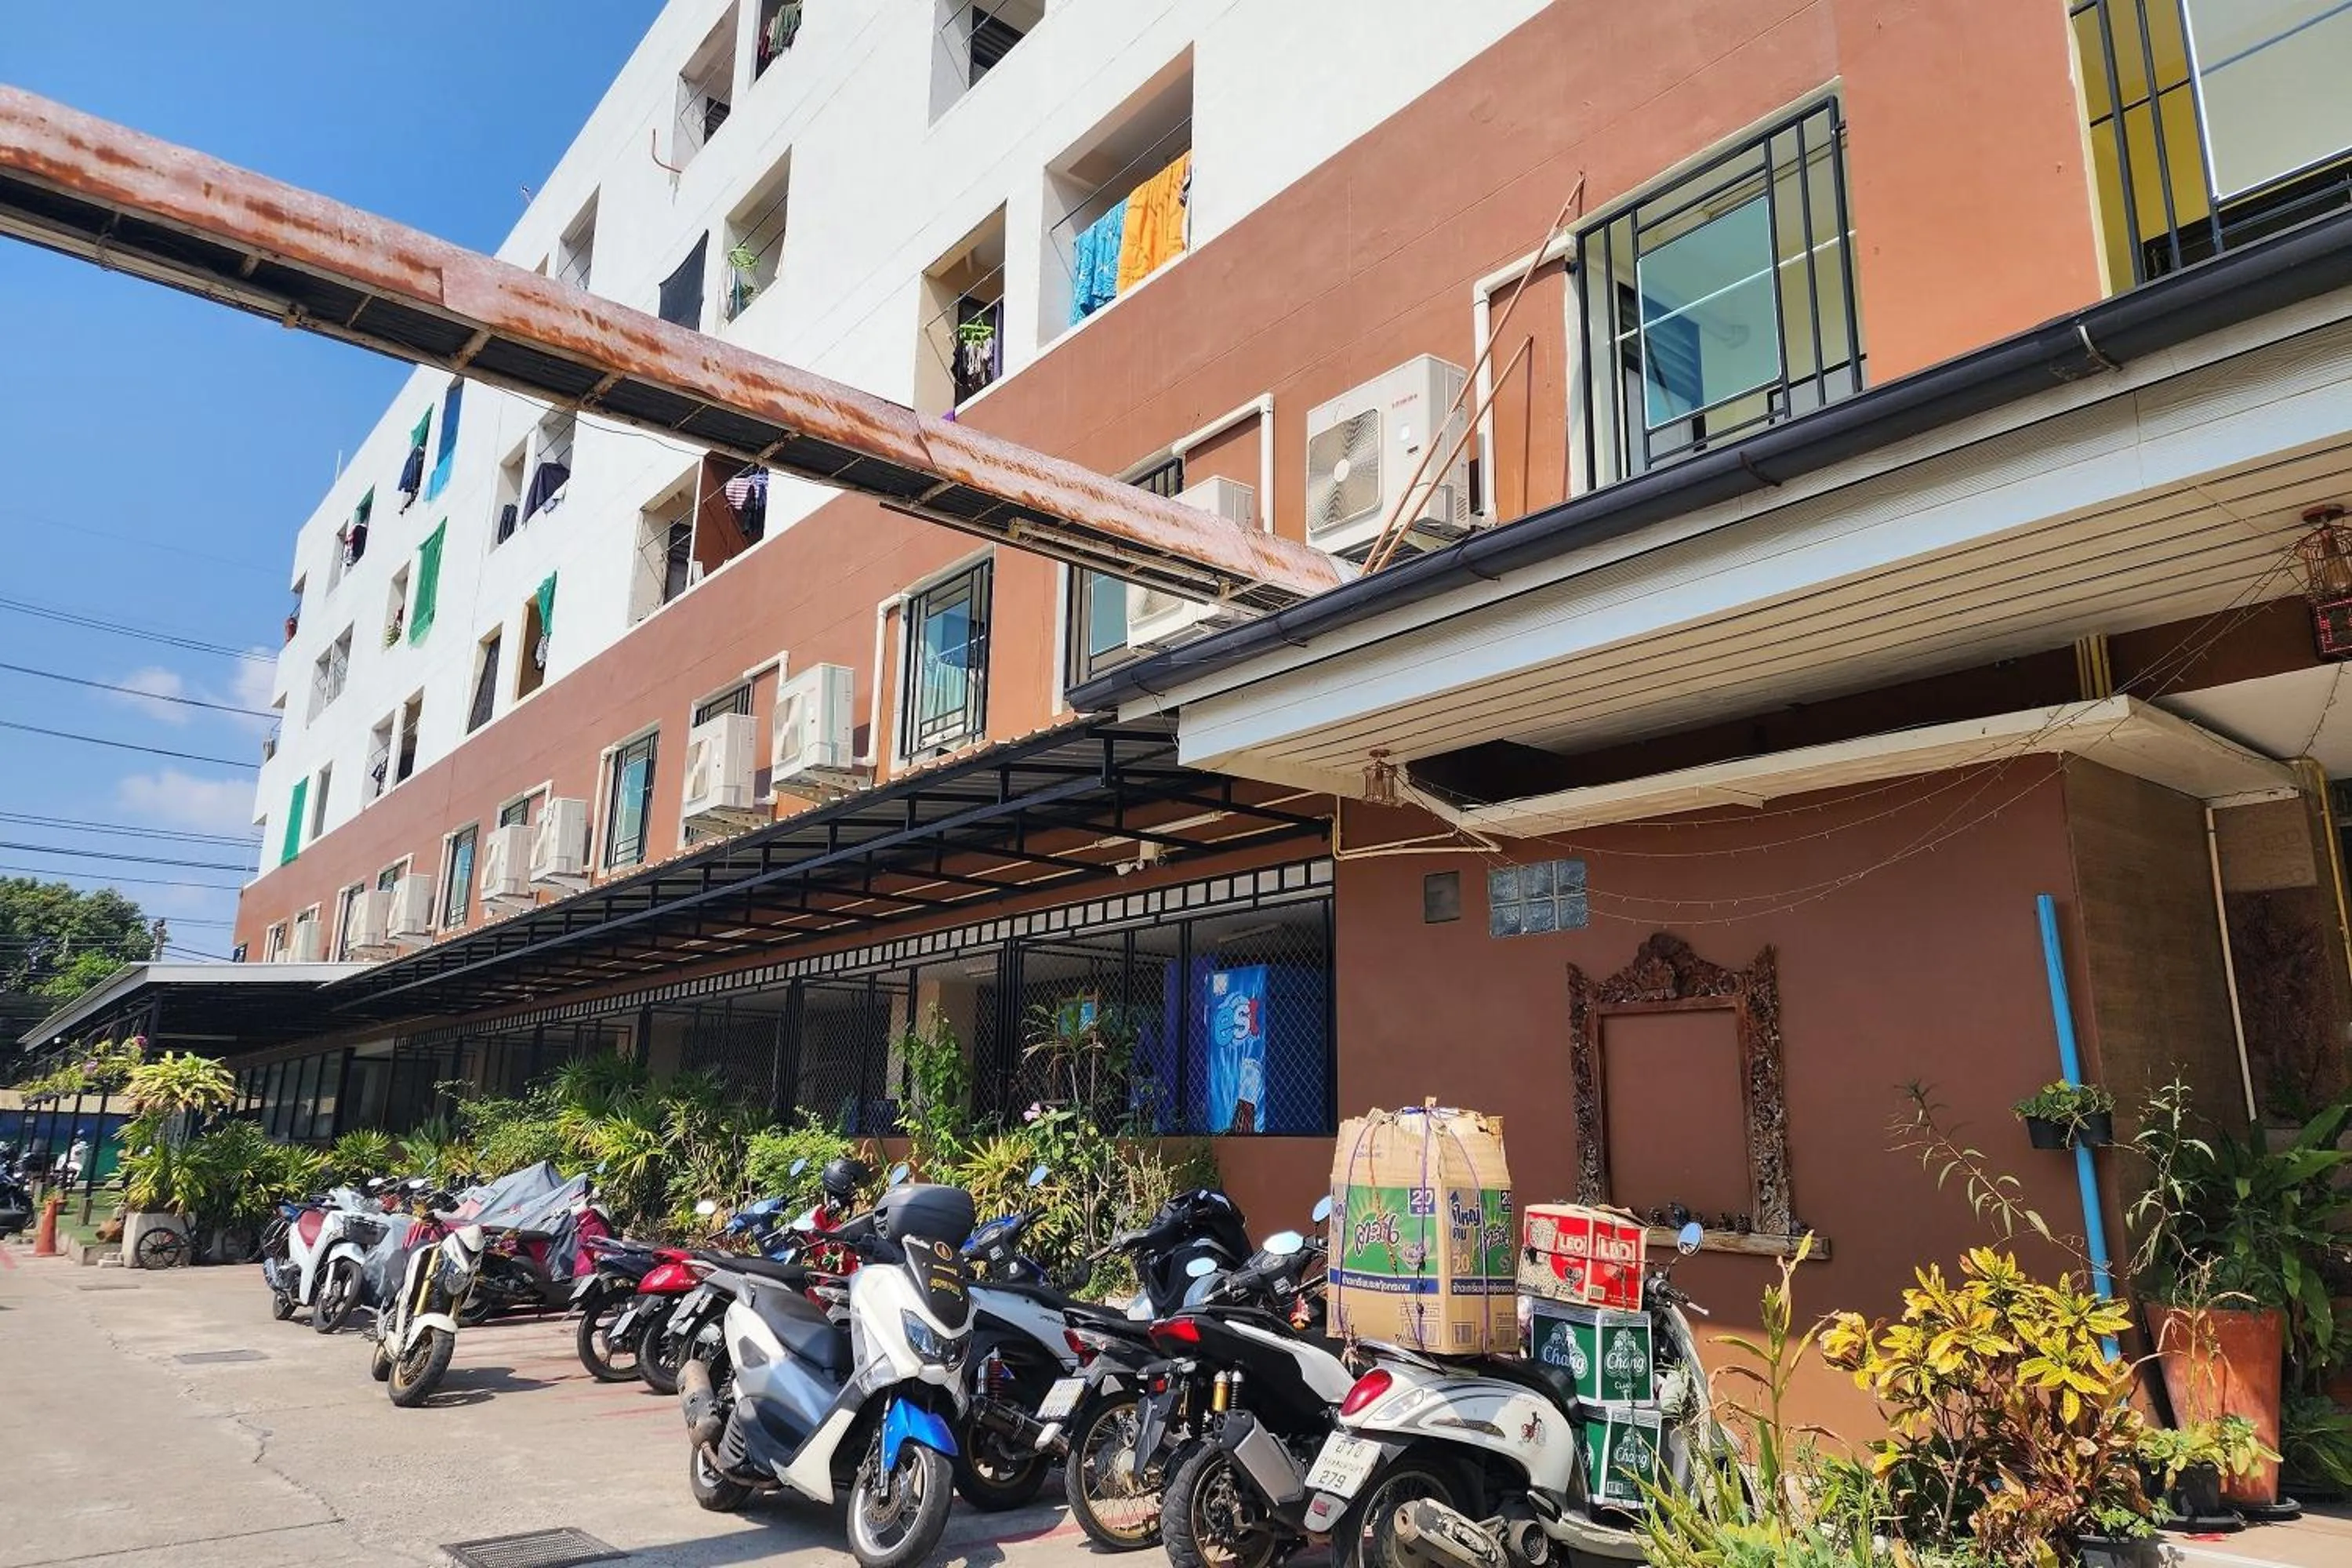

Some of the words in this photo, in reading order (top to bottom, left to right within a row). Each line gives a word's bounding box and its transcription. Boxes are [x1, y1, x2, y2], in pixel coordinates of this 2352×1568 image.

[1411, 1190, 1434, 1205] 20
[1559, 1235, 1583, 1253] LEO
[1543, 1345, 1584, 1370] Chang
[1608, 1352, 1644, 1372] Chang
[1319, 1470, 1346, 1489] 279
